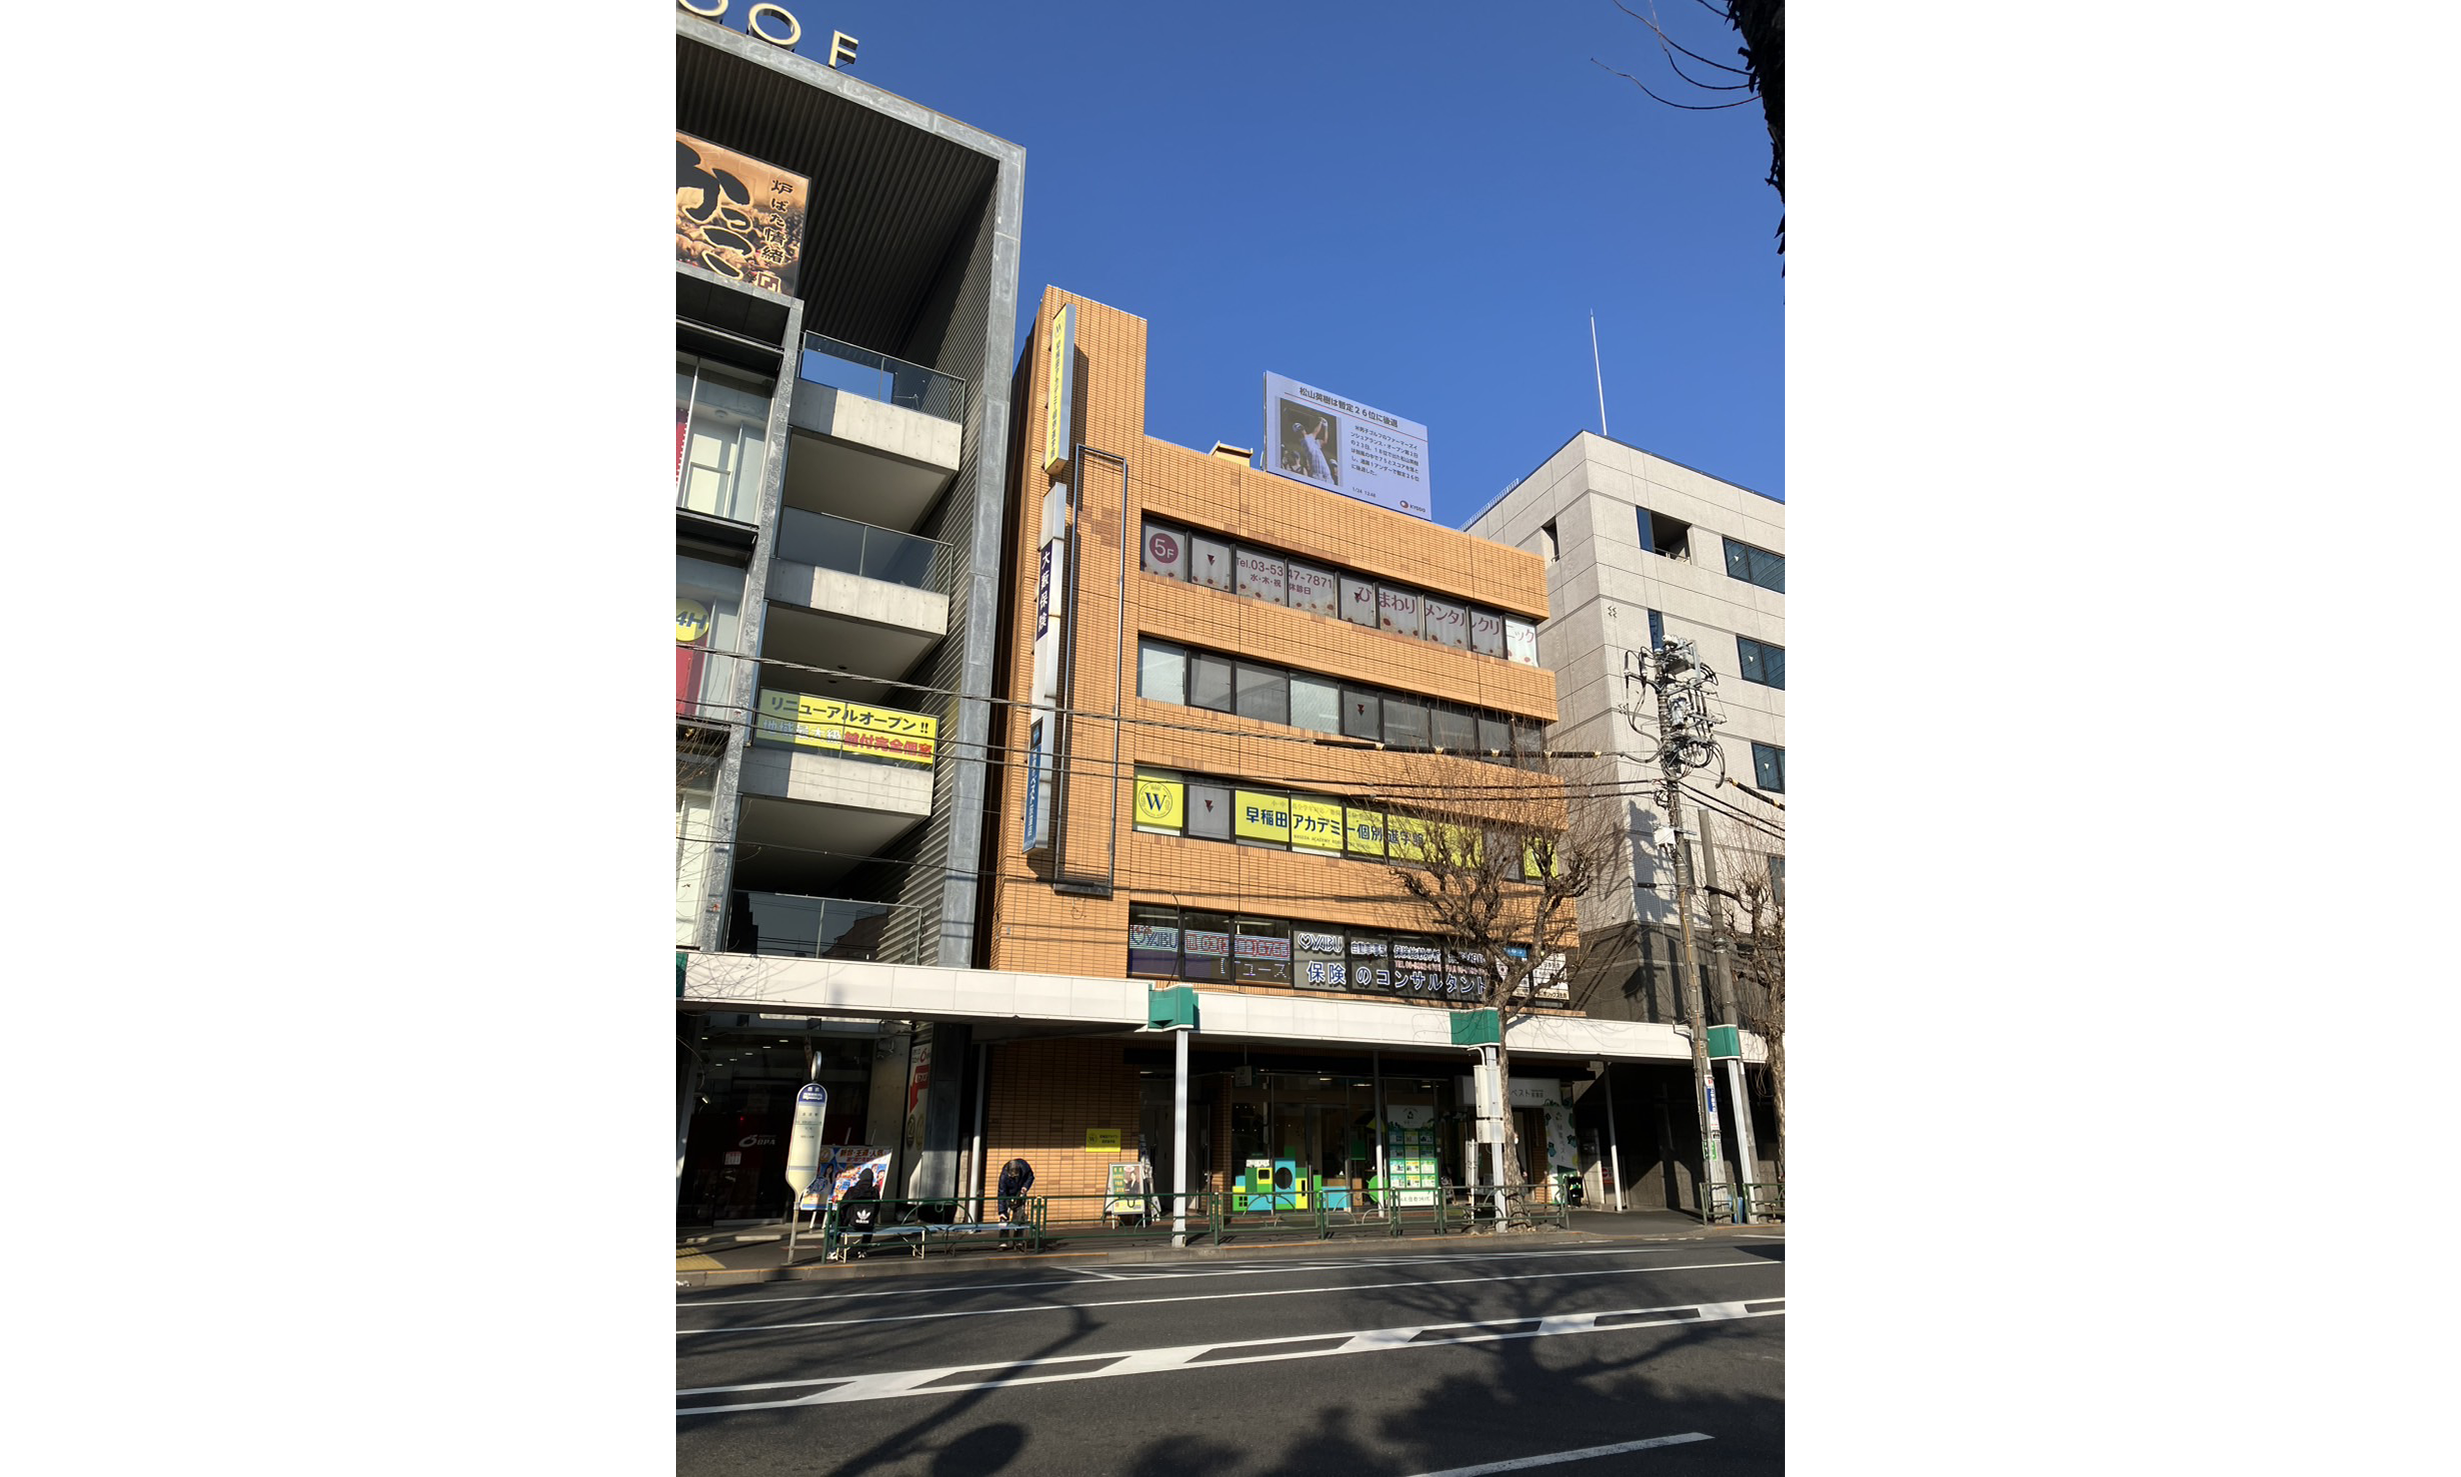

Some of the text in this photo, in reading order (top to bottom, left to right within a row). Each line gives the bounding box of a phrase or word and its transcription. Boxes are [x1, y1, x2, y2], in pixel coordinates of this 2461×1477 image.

[761, 178, 794, 266] 炉ばた情緒
[1154, 538, 1175, 559] 5F
[1145, 792, 1167, 811] W
